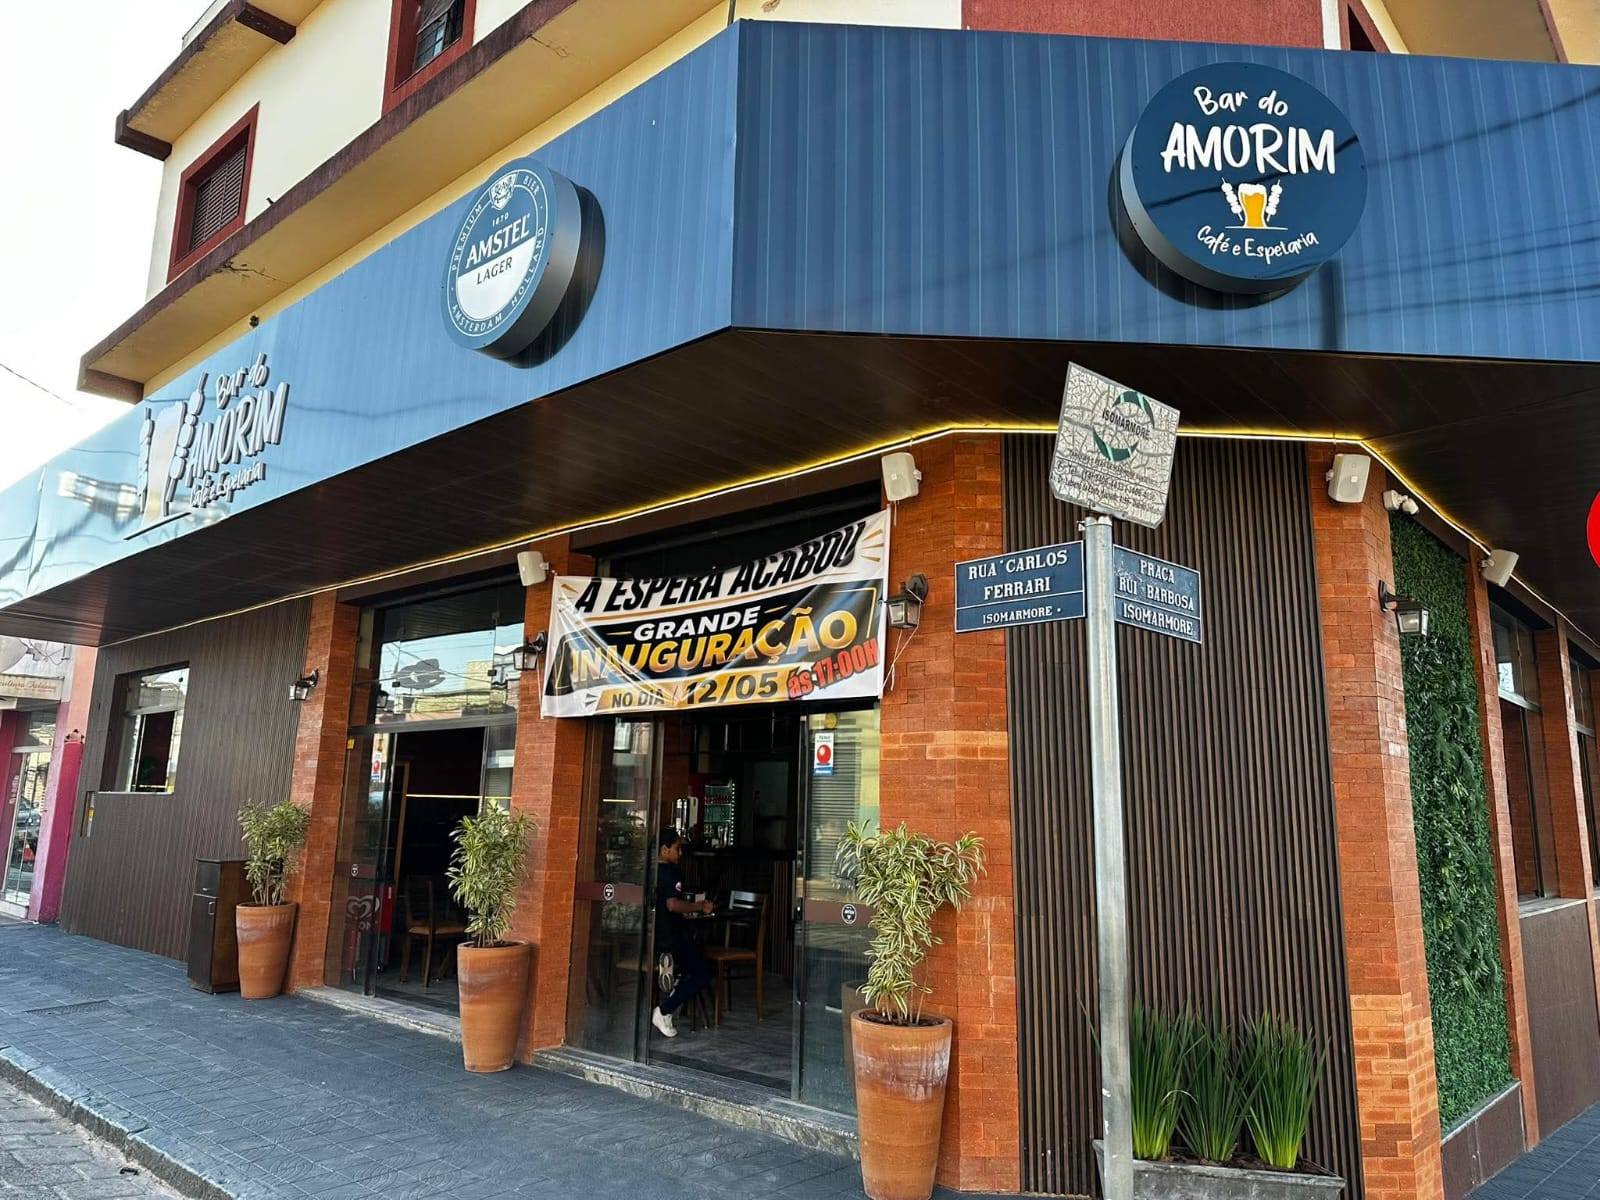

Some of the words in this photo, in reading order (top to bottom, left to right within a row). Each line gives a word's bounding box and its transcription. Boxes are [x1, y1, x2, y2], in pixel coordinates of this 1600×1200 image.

[1194, 86, 1248, 115] Bar
[1258, 90, 1289, 116] do
[1160, 122, 1336, 174] AMORIM
[451, 204, 482, 271] PREMIUM
[465, 215, 530, 269] AMSTEL
[1197, 225, 1230, 256] Café
[1232, 245, 1241, 255] e
[476, 256, 513, 285] LAGER
[511, 227, 545, 307] HOLLAND
[451, 303, 503, 333] AMSTERDAM
[215, 367, 248, 410] Bar
[248, 352, 270, 388] do
[186, 382, 289, 488] AMORIM
[1102, 408, 1151, 441] ISOMARMORE
[574, 576, 602, 613] A
[603, 572, 725, 612] ESPERA
[727, 520, 866, 597] ACABOU
[968, 561, 997, 580] RUA
[1006, 549, 1068, 573] CARLOS
[983, 576, 1054, 600] FERRARI
[1119, 576, 1138, 595] RUI
[1147, 585, 1195, 611] BARBOSA
[634, 604, 762, 641] GRANDE
[983, 605, 1053, 625] ISOMARMORE
[1123, 603, 1193, 636] ISOMARMORE
[570, 605, 858, 684] INAUGURAÇÃO
[612, 691, 633, 708] NO
[638, 688, 665, 706] DIA
[686, 670, 778, 705] 12/05
